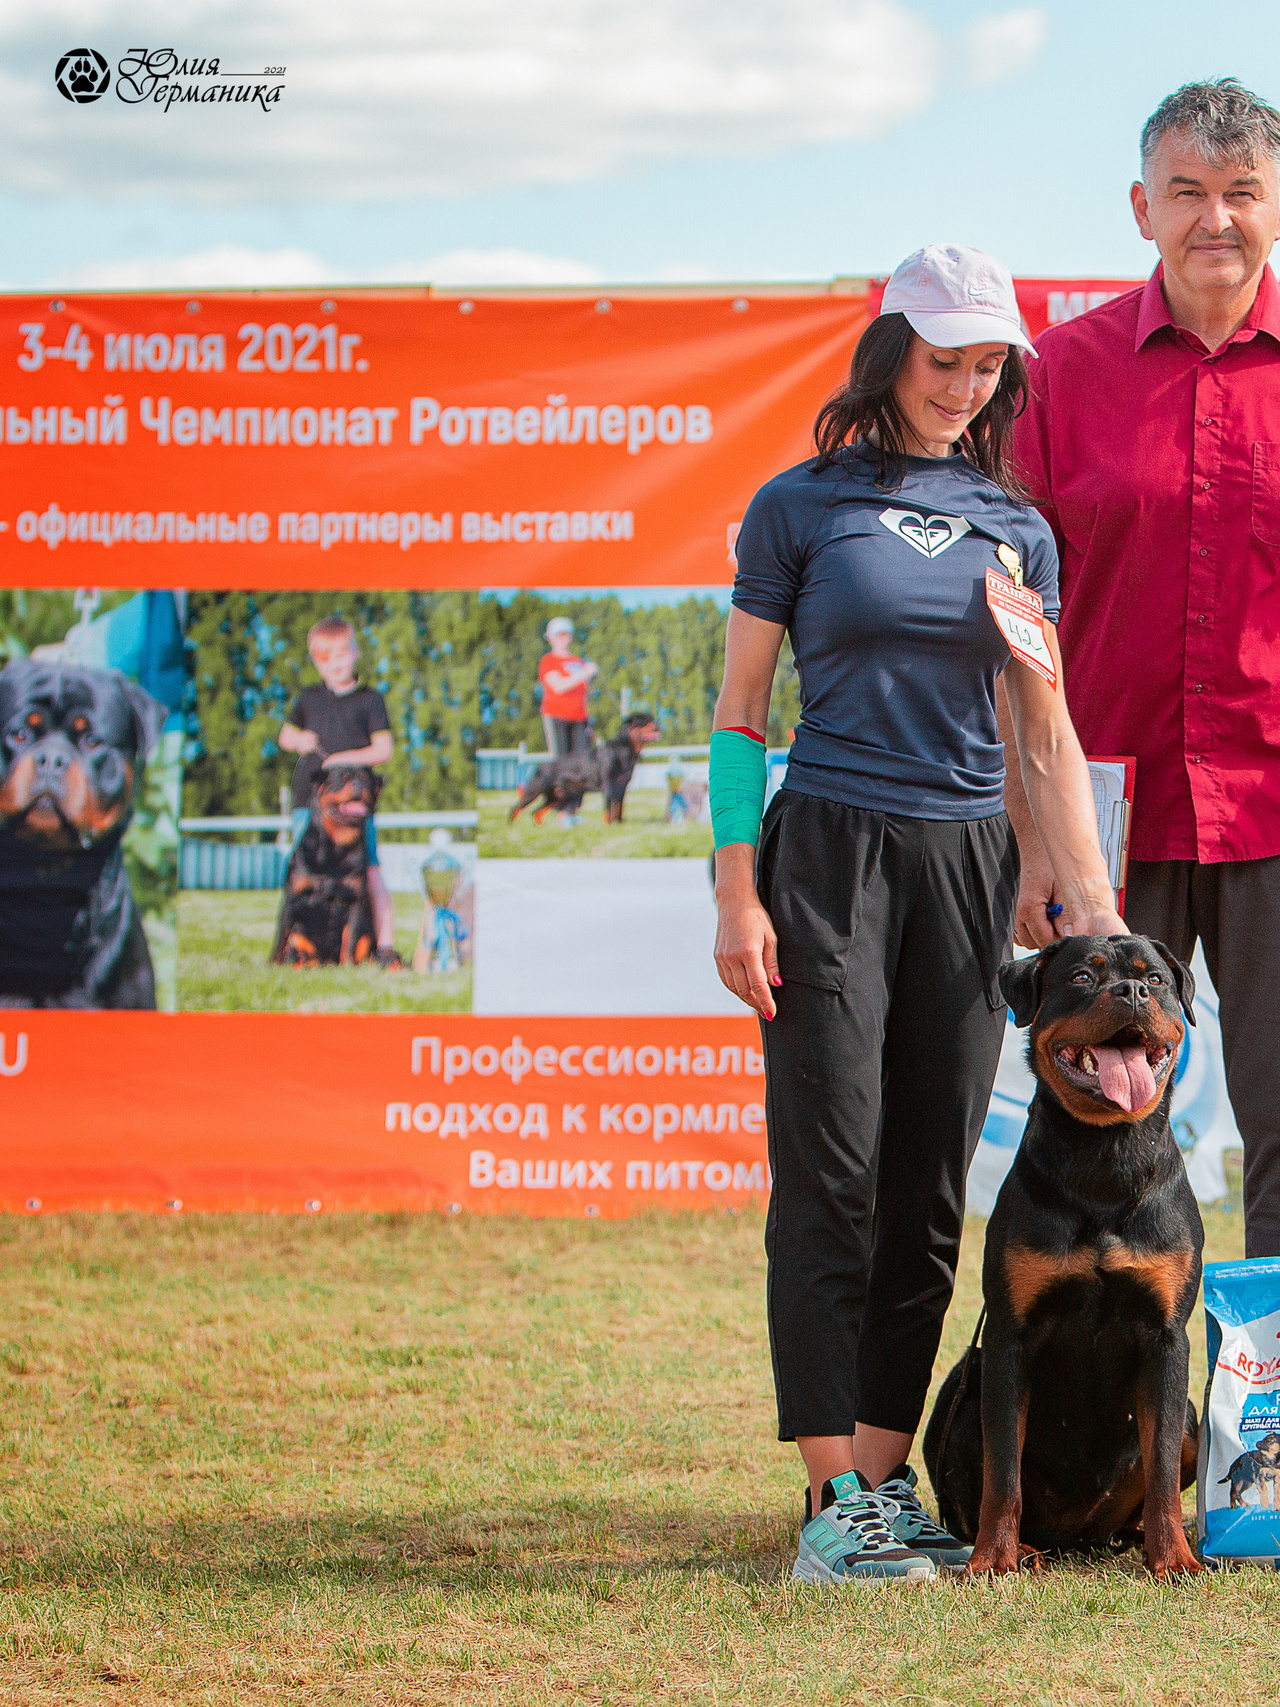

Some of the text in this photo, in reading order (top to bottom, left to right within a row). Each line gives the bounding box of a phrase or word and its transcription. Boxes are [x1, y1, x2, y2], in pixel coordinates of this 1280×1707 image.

[17, 323, 370, 373] 3-4 июля 2021г.
[139, 396, 399, 446] Чемпионат
[409, 393, 714, 454] Ротвейлеров
[16, 502, 270, 551] официальные
[278, 510, 454, 551] партнеры
[461, 509, 634, 544] выставки
[988, 577, 1041, 610] ТРАПЕЗА
[411, 1036, 765, 1084] Профессиональ
[385, 1100, 765, 1143] подход к кормле
[469, 1149, 773, 1191] Ваших питом
[1248, 1405, 1279, 1417] ДЛЯ
